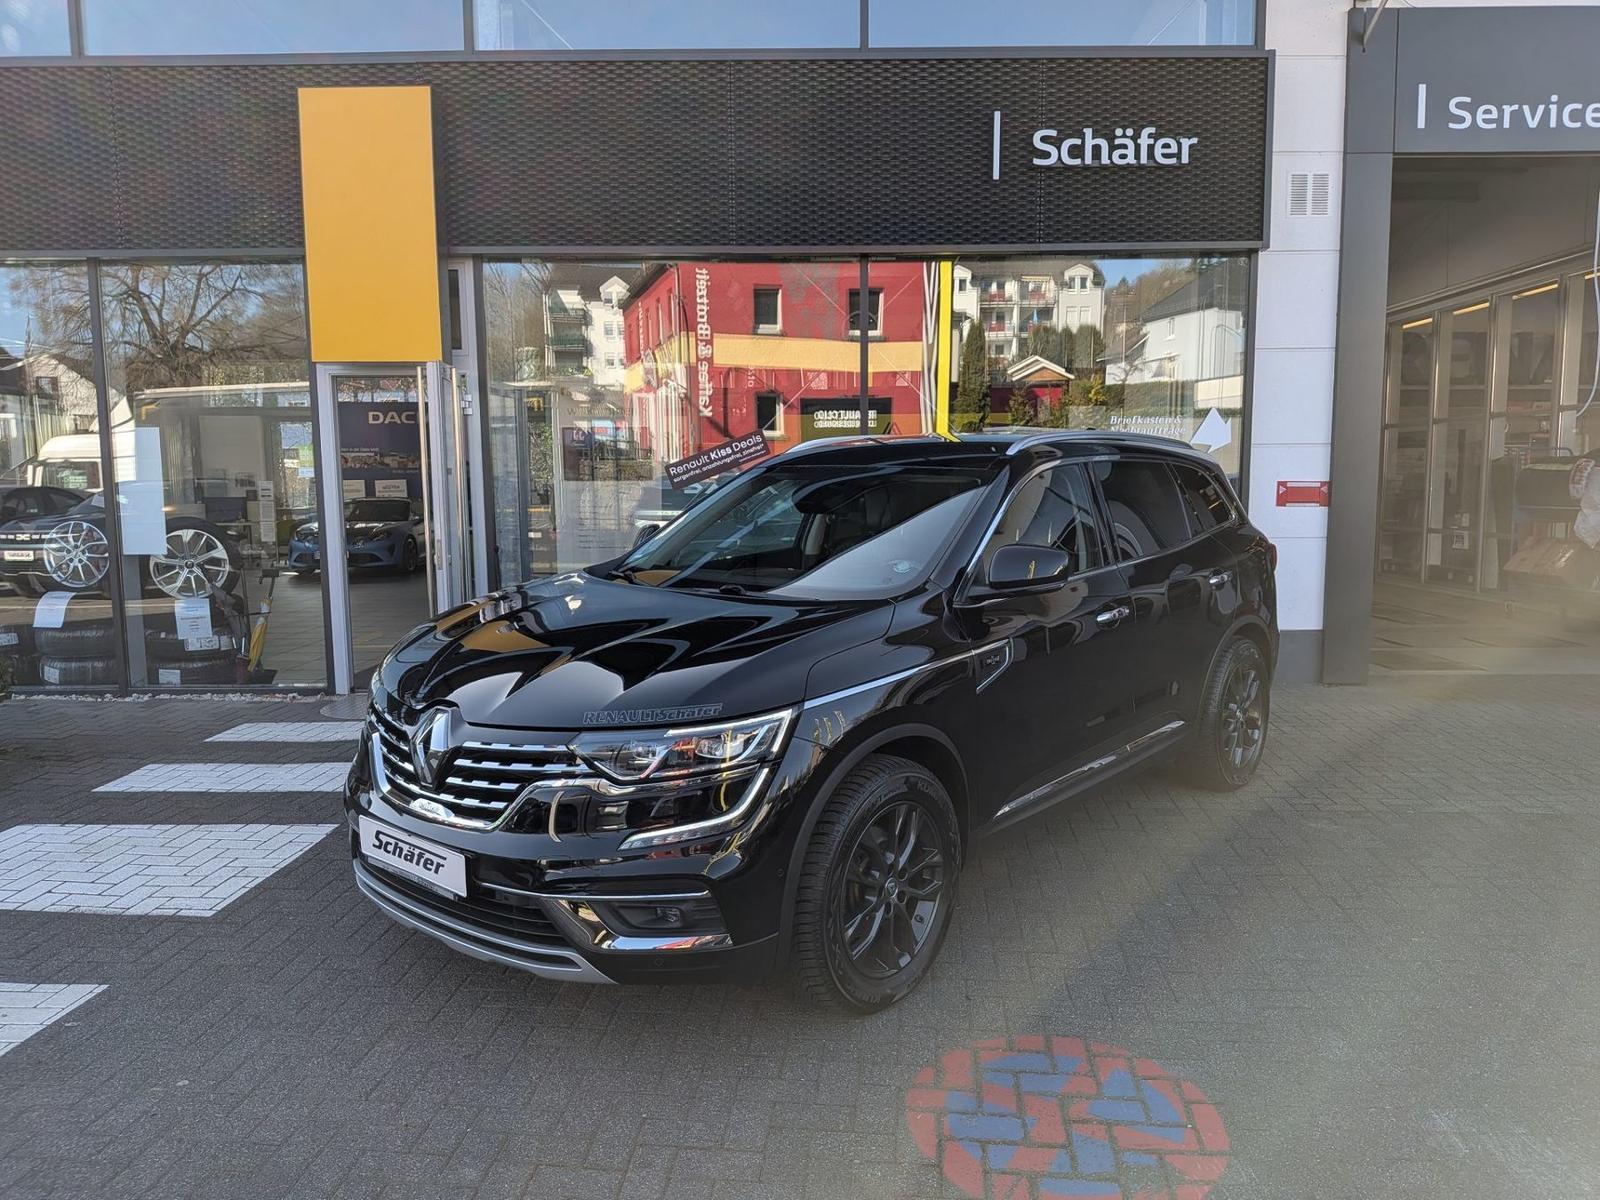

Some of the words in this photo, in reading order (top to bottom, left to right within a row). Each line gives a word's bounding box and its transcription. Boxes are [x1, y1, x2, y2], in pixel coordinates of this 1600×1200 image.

[1032, 127, 1199, 166] Schäfer
[1110, 416, 1172, 425] Briefkasten
[669, 455, 710, 476] Renault
[709, 446, 732, 460] Kiss
[732, 434, 762, 452] Deals
[372, 829, 447, 875] Schäfer
